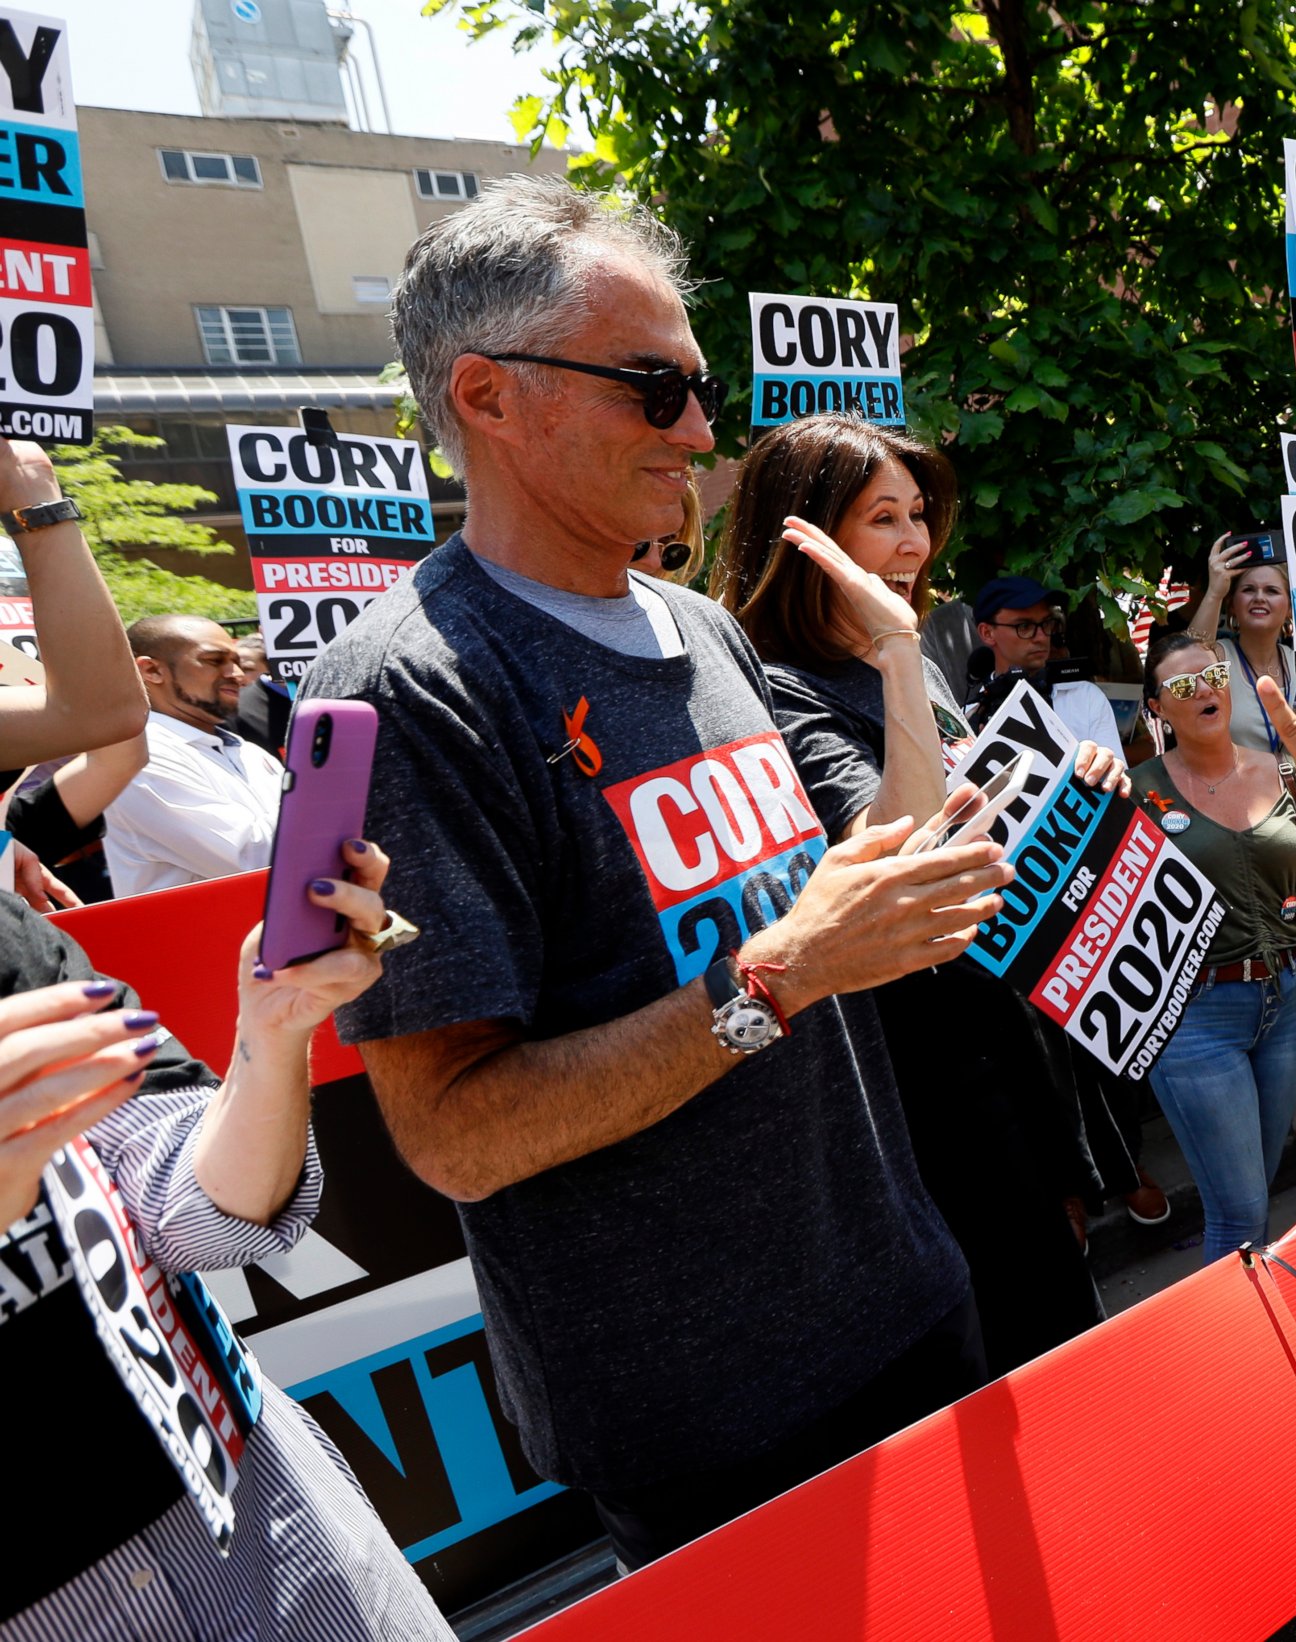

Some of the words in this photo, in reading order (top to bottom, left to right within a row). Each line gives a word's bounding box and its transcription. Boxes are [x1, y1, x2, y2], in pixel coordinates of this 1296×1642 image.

[759, 302, 895, 369] CORY
[761, 380, 901, 419] BOOKER
[238, 432, 415, 491] CORY
[249, 494, 428, 535] BOOKER
[330, 537, 370, 554] FOR
[630, 739, 820, 892] COR
[1041, 821, 1157, 1014] PRESIDENT
[1061, 865, 1097, 912] FOR
[1079, 857, 1203, 1065] 2020
[1128, 901, 1226, 1081] CORYBOOKER.COM
